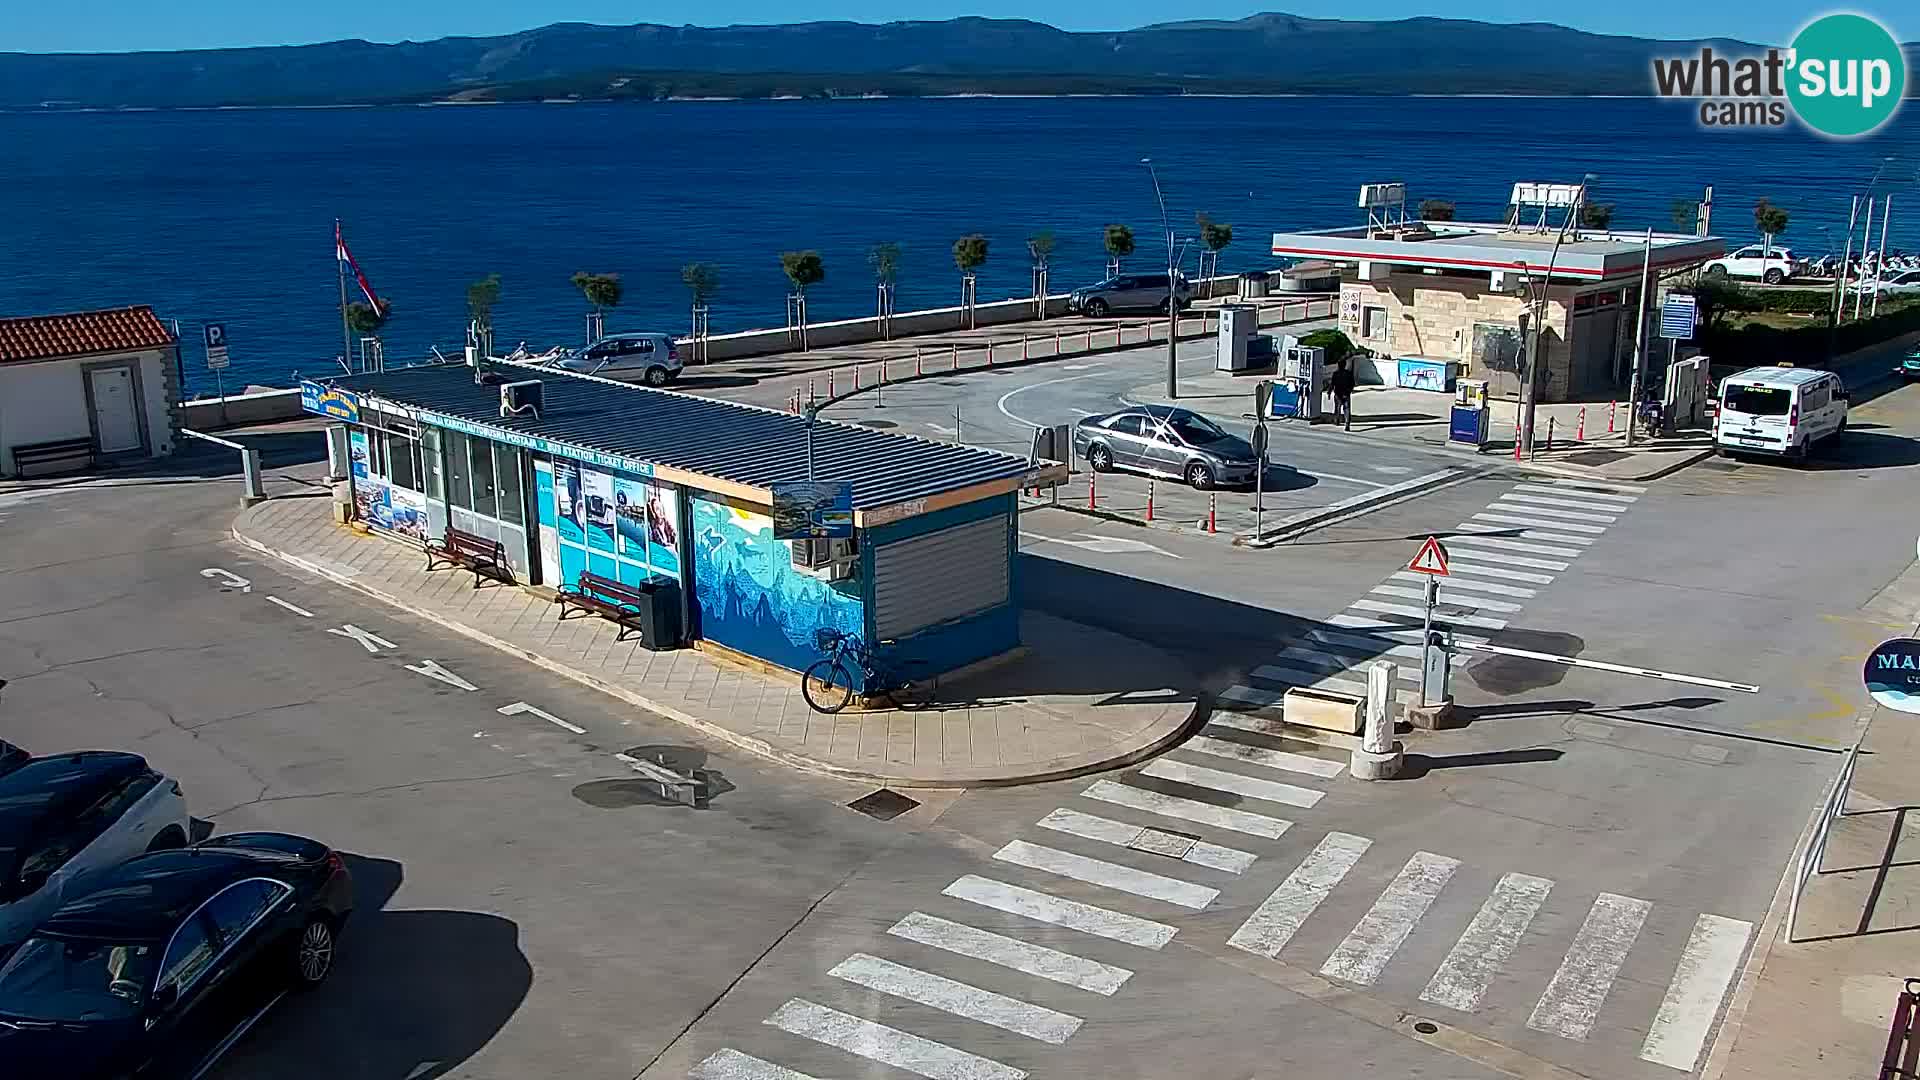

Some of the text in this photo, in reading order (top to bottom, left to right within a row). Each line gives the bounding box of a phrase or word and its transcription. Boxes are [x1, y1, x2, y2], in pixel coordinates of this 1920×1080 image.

[209, 327, 221, 345] P
[506, 432, 538, 449] POSTAJA
[547, 443, 650, 474] BUS STATION TICKET OFFICE
[1876, 654, 1920, 670] MA
